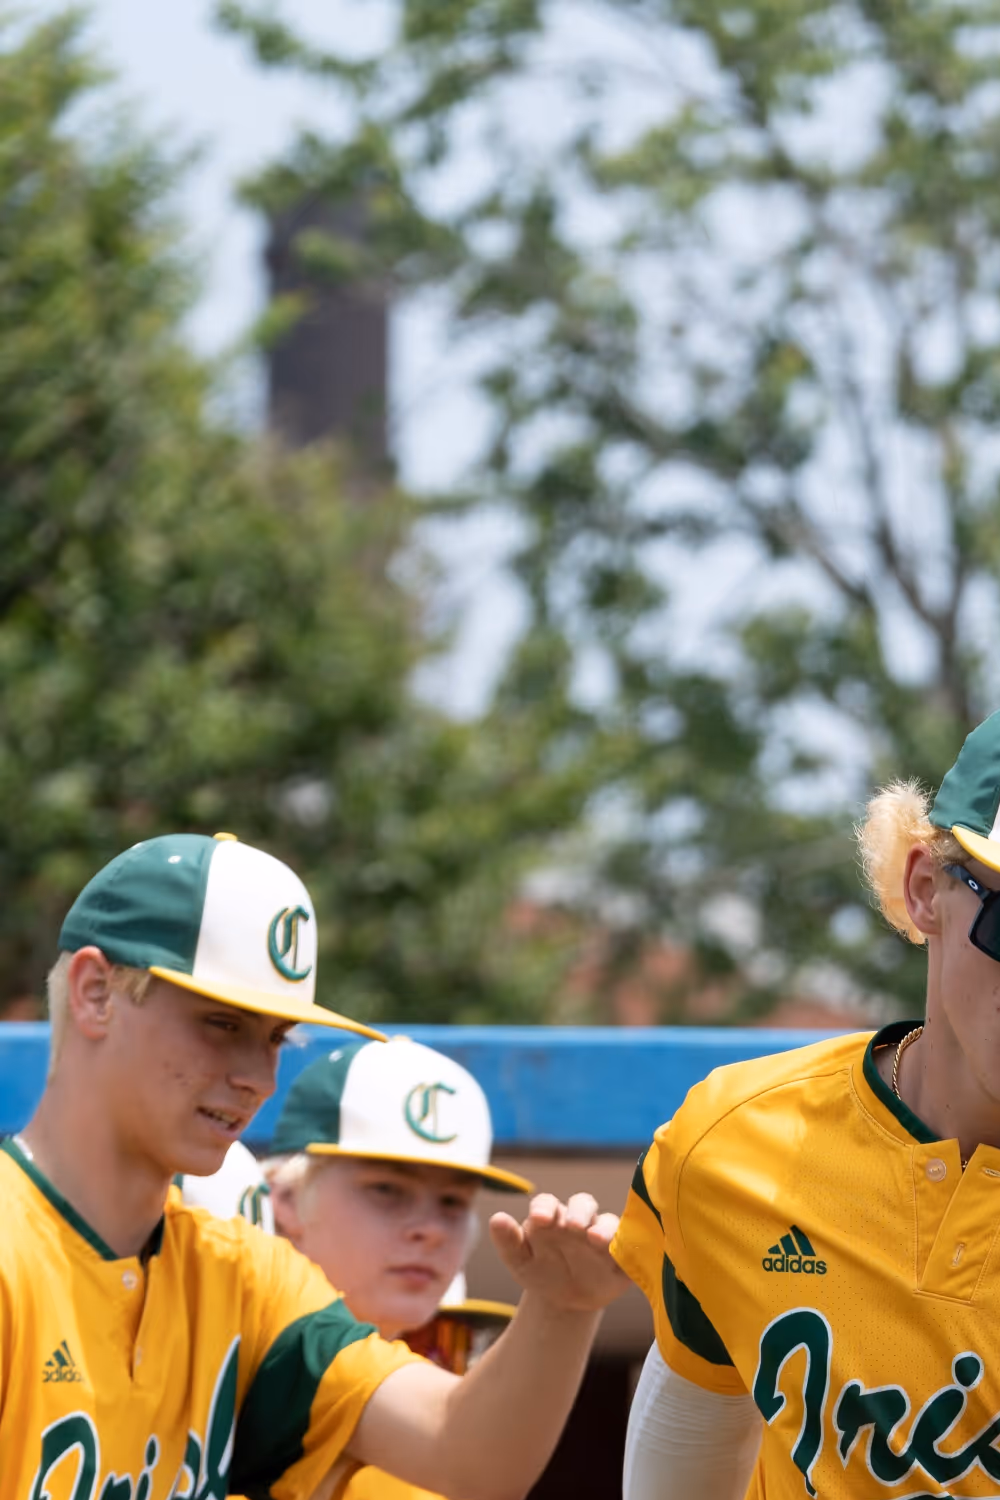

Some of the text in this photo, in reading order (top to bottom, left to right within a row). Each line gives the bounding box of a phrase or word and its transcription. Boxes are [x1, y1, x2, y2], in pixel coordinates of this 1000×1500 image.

[266, 902, 312, 983] C
[404, 1081, 457, 1144] C
[761, 1252, 827, 1276] adidas
